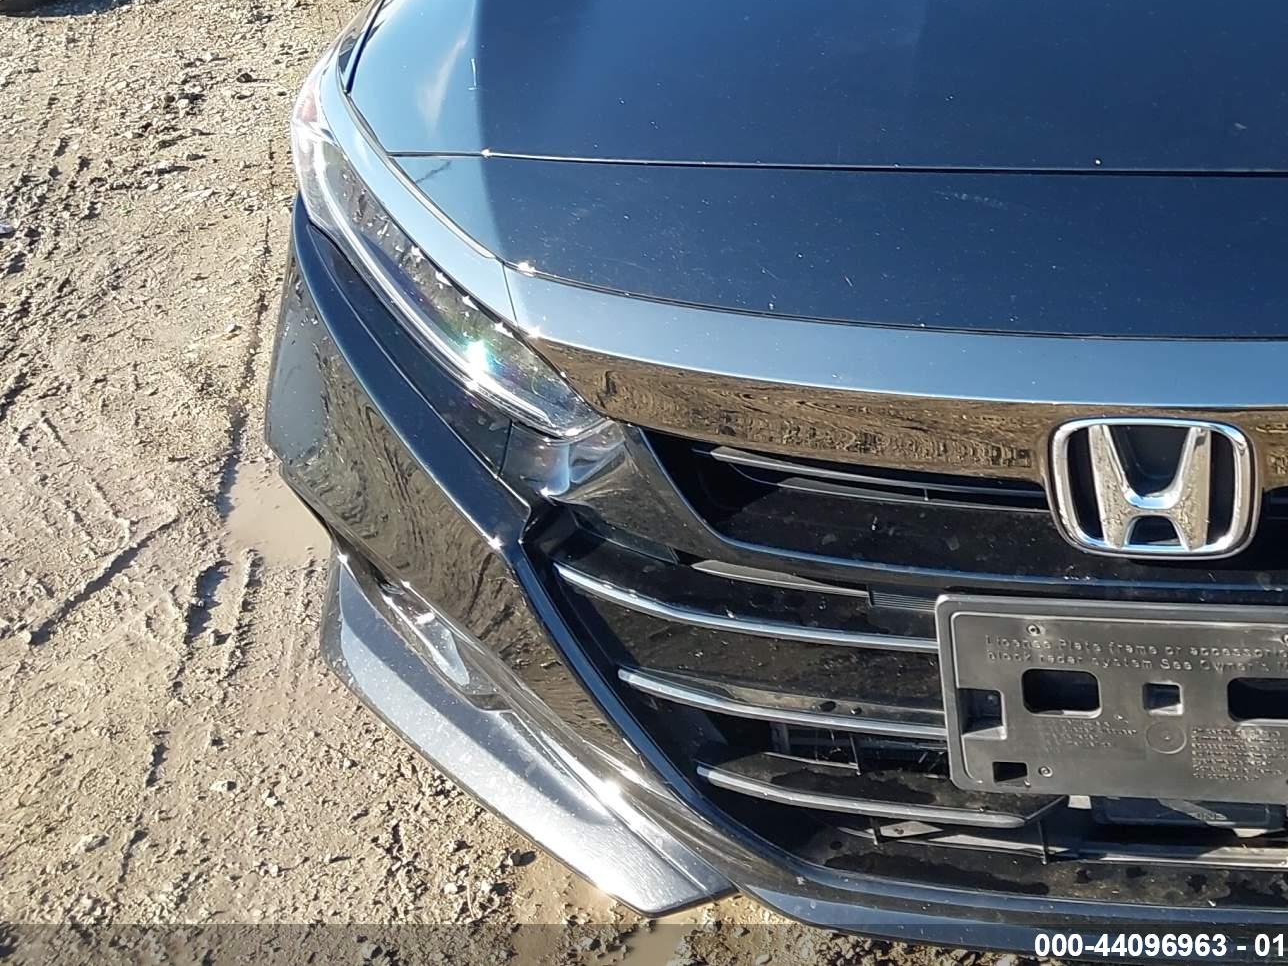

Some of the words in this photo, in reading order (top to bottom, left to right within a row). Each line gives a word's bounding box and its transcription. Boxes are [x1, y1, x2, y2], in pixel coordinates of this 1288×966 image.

[985, 634, 1051, 650] License
[1058, 638, 1102, 653] Plate
[1108, 641, 1158, 656] frame
[1160, 658, 1193, 671] See
